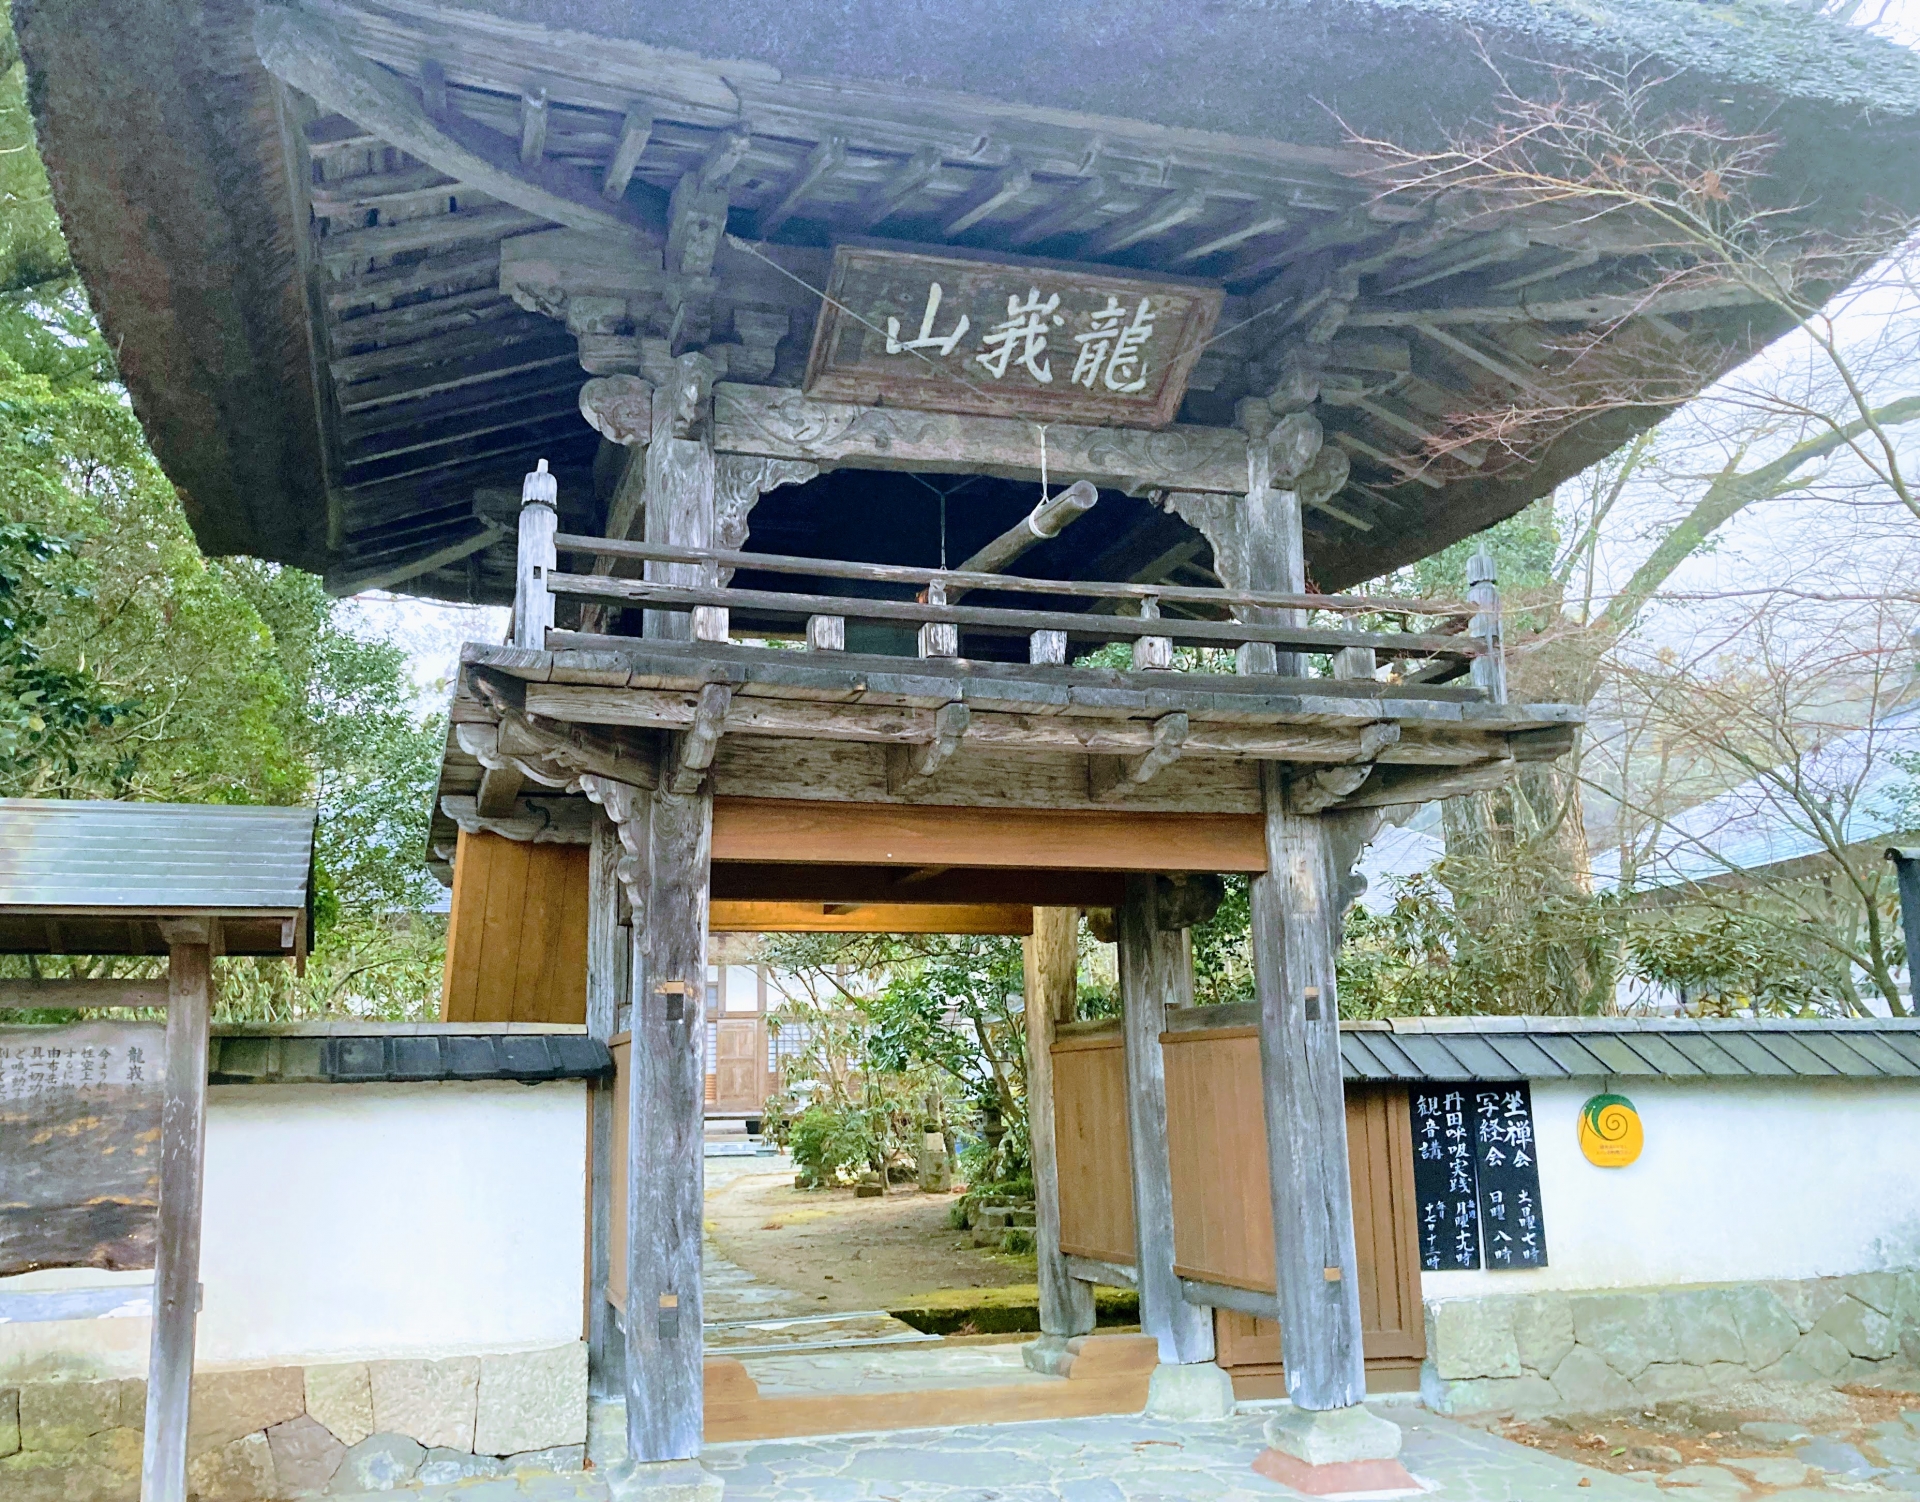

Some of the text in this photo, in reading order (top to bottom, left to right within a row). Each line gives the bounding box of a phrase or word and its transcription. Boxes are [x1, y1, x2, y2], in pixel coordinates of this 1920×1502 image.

[1416, 1094, 1444, 1160] 観音講
[1476, 1092, 1506, 1167] 写経会
[1500, 1090, 1533, 1168] 坐禅会
